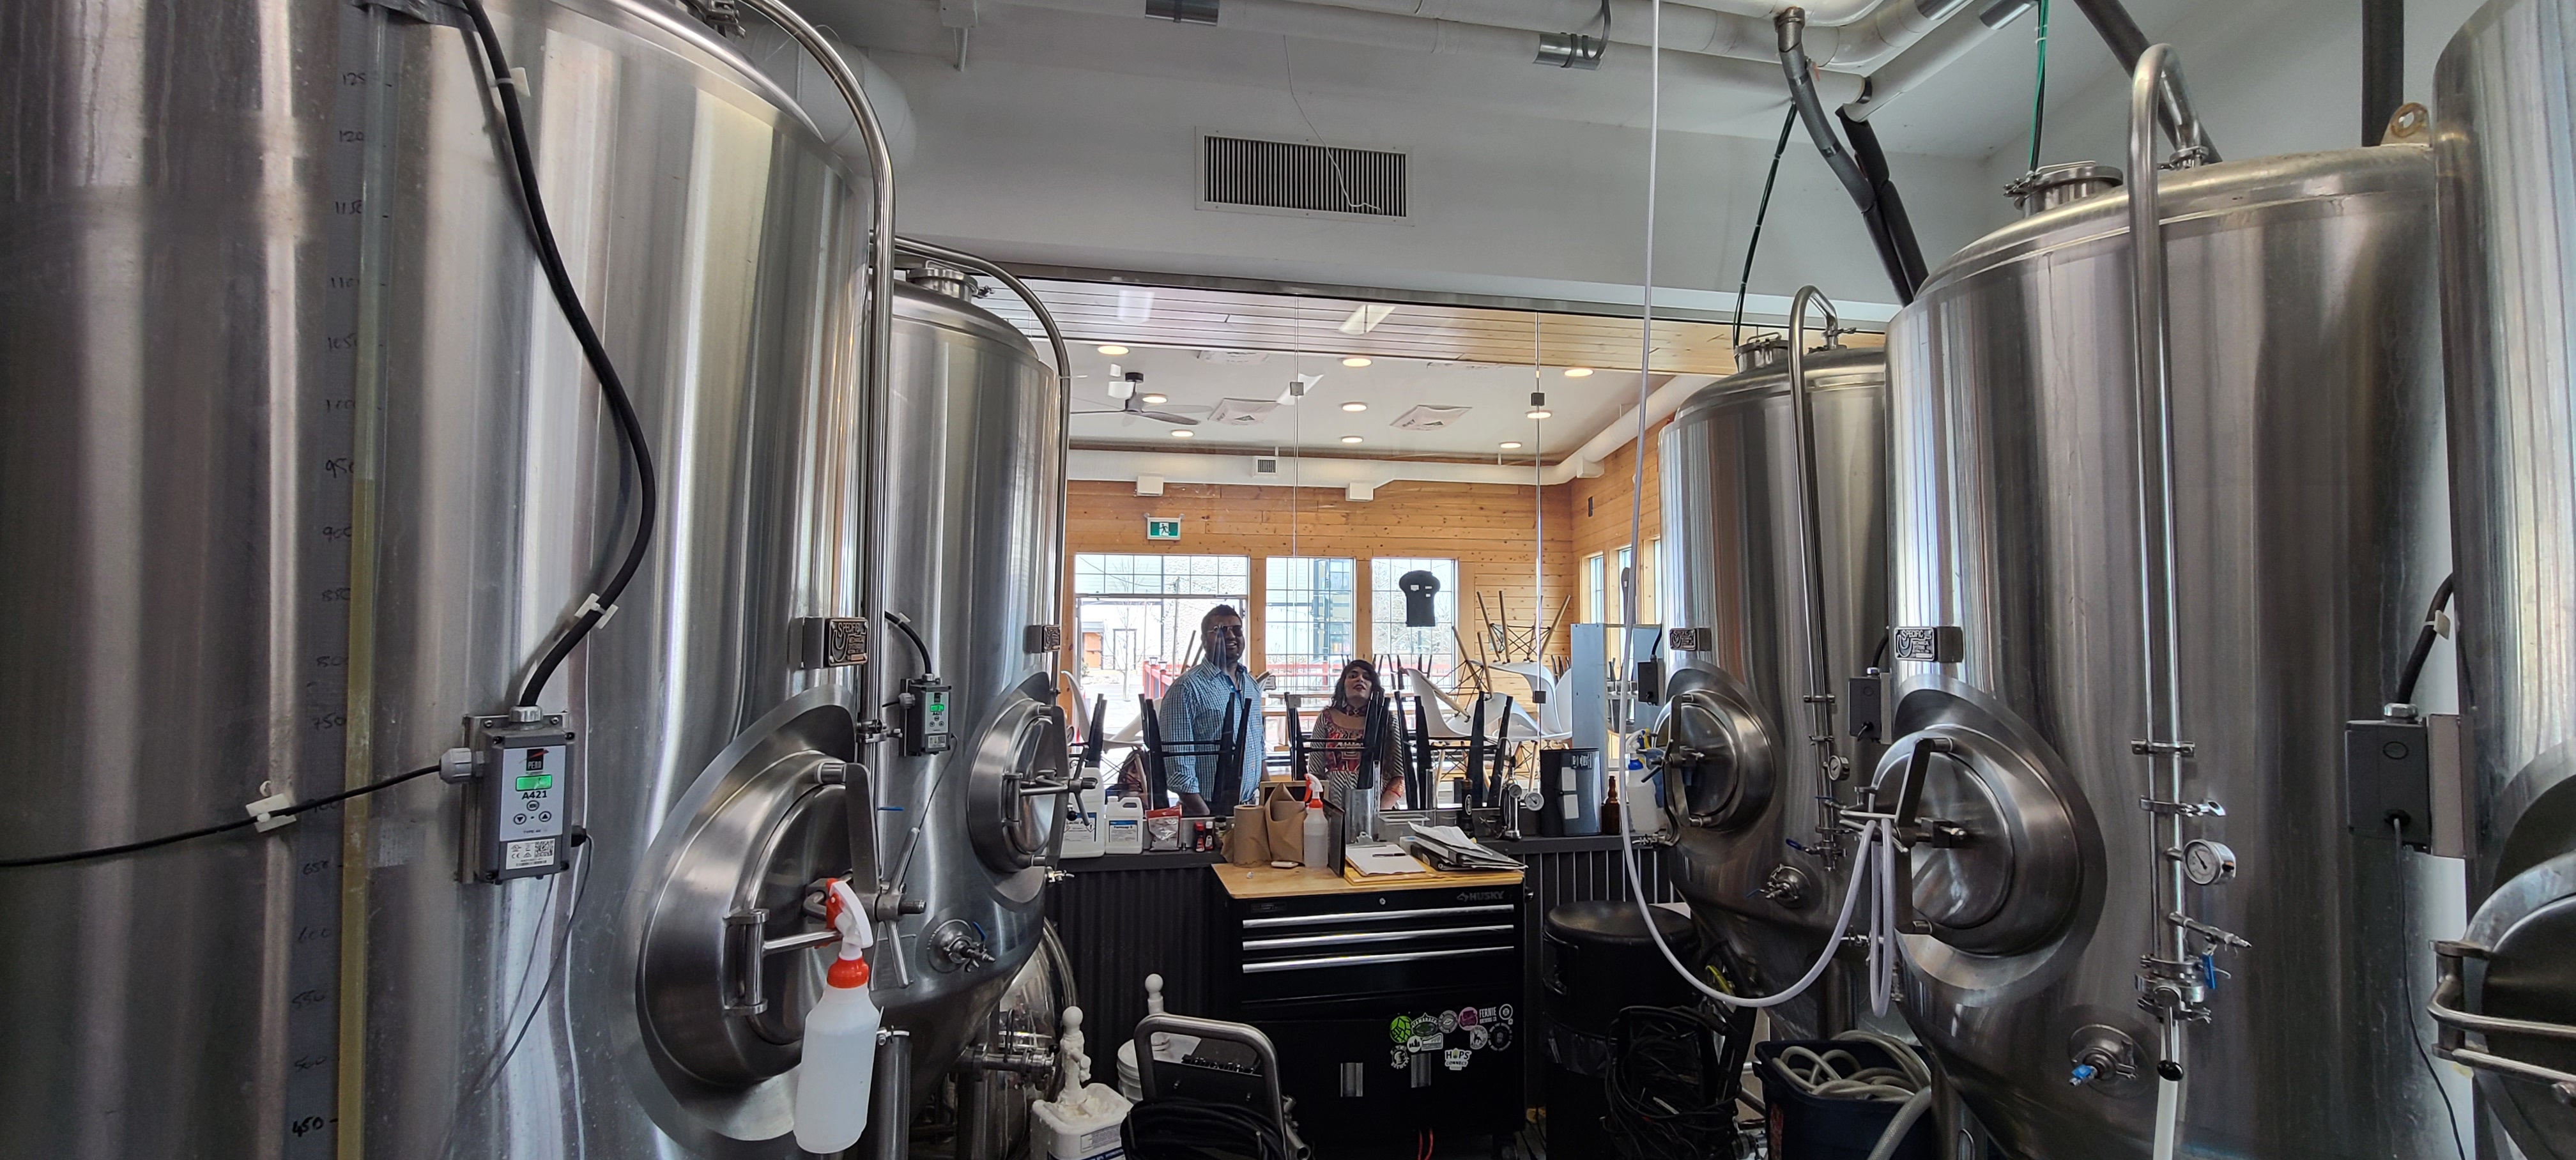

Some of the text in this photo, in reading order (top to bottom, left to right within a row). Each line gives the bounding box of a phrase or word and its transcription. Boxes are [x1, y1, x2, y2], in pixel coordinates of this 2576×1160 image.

[521, 790, 548, 800] A421
[1469, 890, 1505, 901] HUSKY
[1479, 1007, 1497, 1018] FERNIE
[292, 1119, 324, 1138] 450
